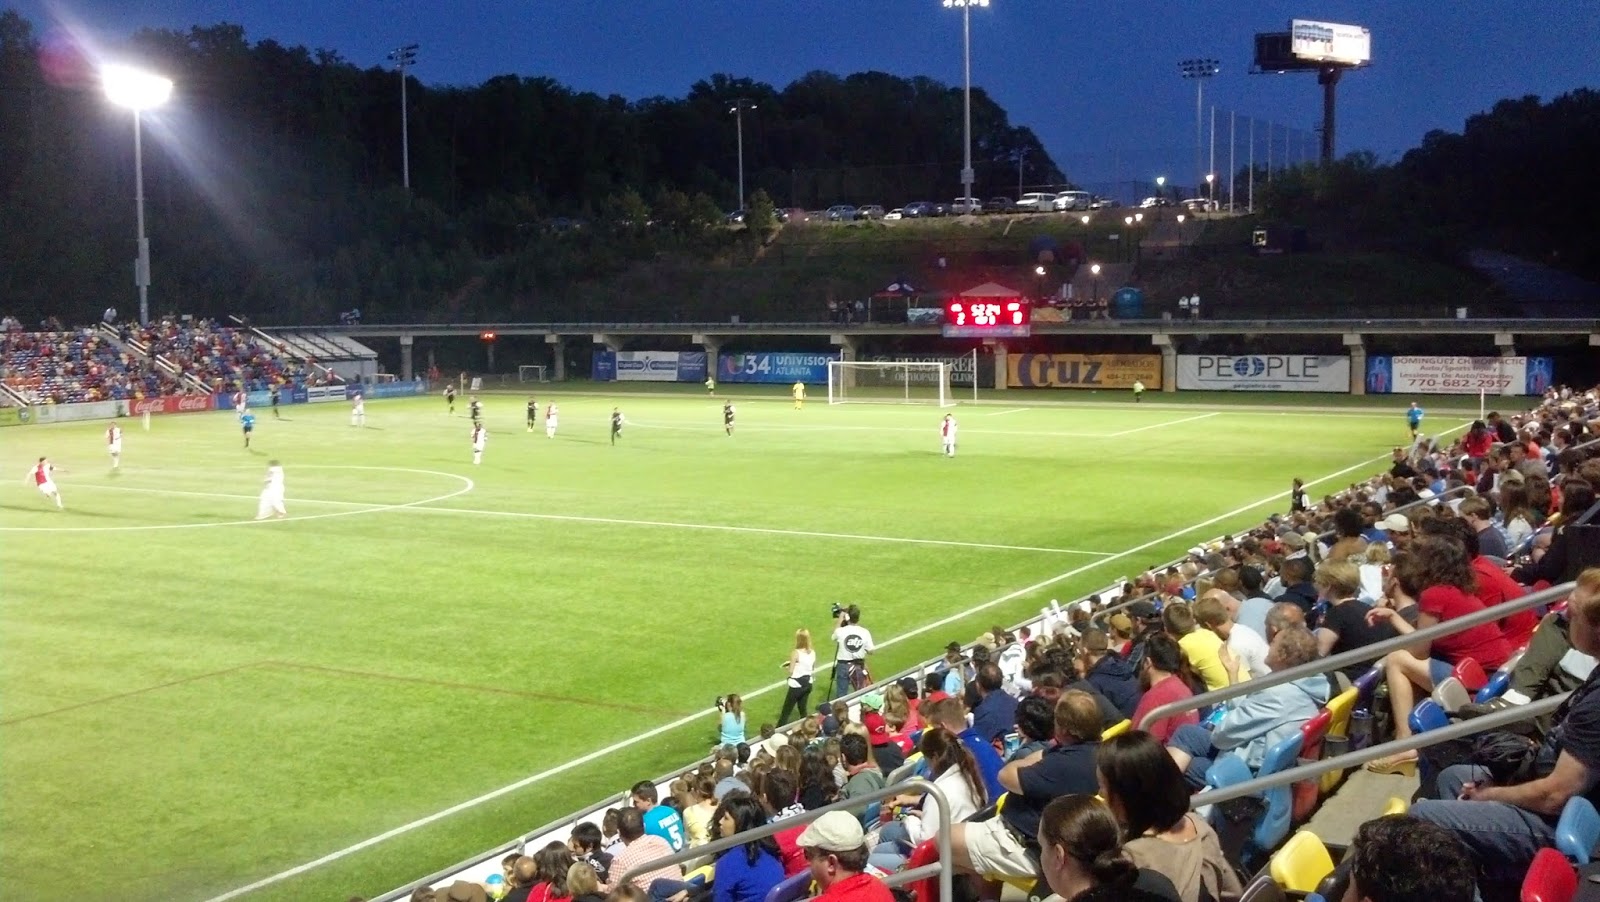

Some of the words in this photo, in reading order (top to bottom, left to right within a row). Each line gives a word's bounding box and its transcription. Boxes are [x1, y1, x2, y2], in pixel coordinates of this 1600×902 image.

[745, 355, 771, 375] 34
[775, 356, 834, 366] UNIVISION
[1017, 351, 1102, 388] Cruz
[1198, 356, 1319, 377] PEOPLE
[1393, 357, 1455, 365] DOMINGUEZ
[775, 367, 812, 376] ATLANTA
[1408, 379, 1511, 388] 770-682-2957
[668, 824, 683, 850] 5
